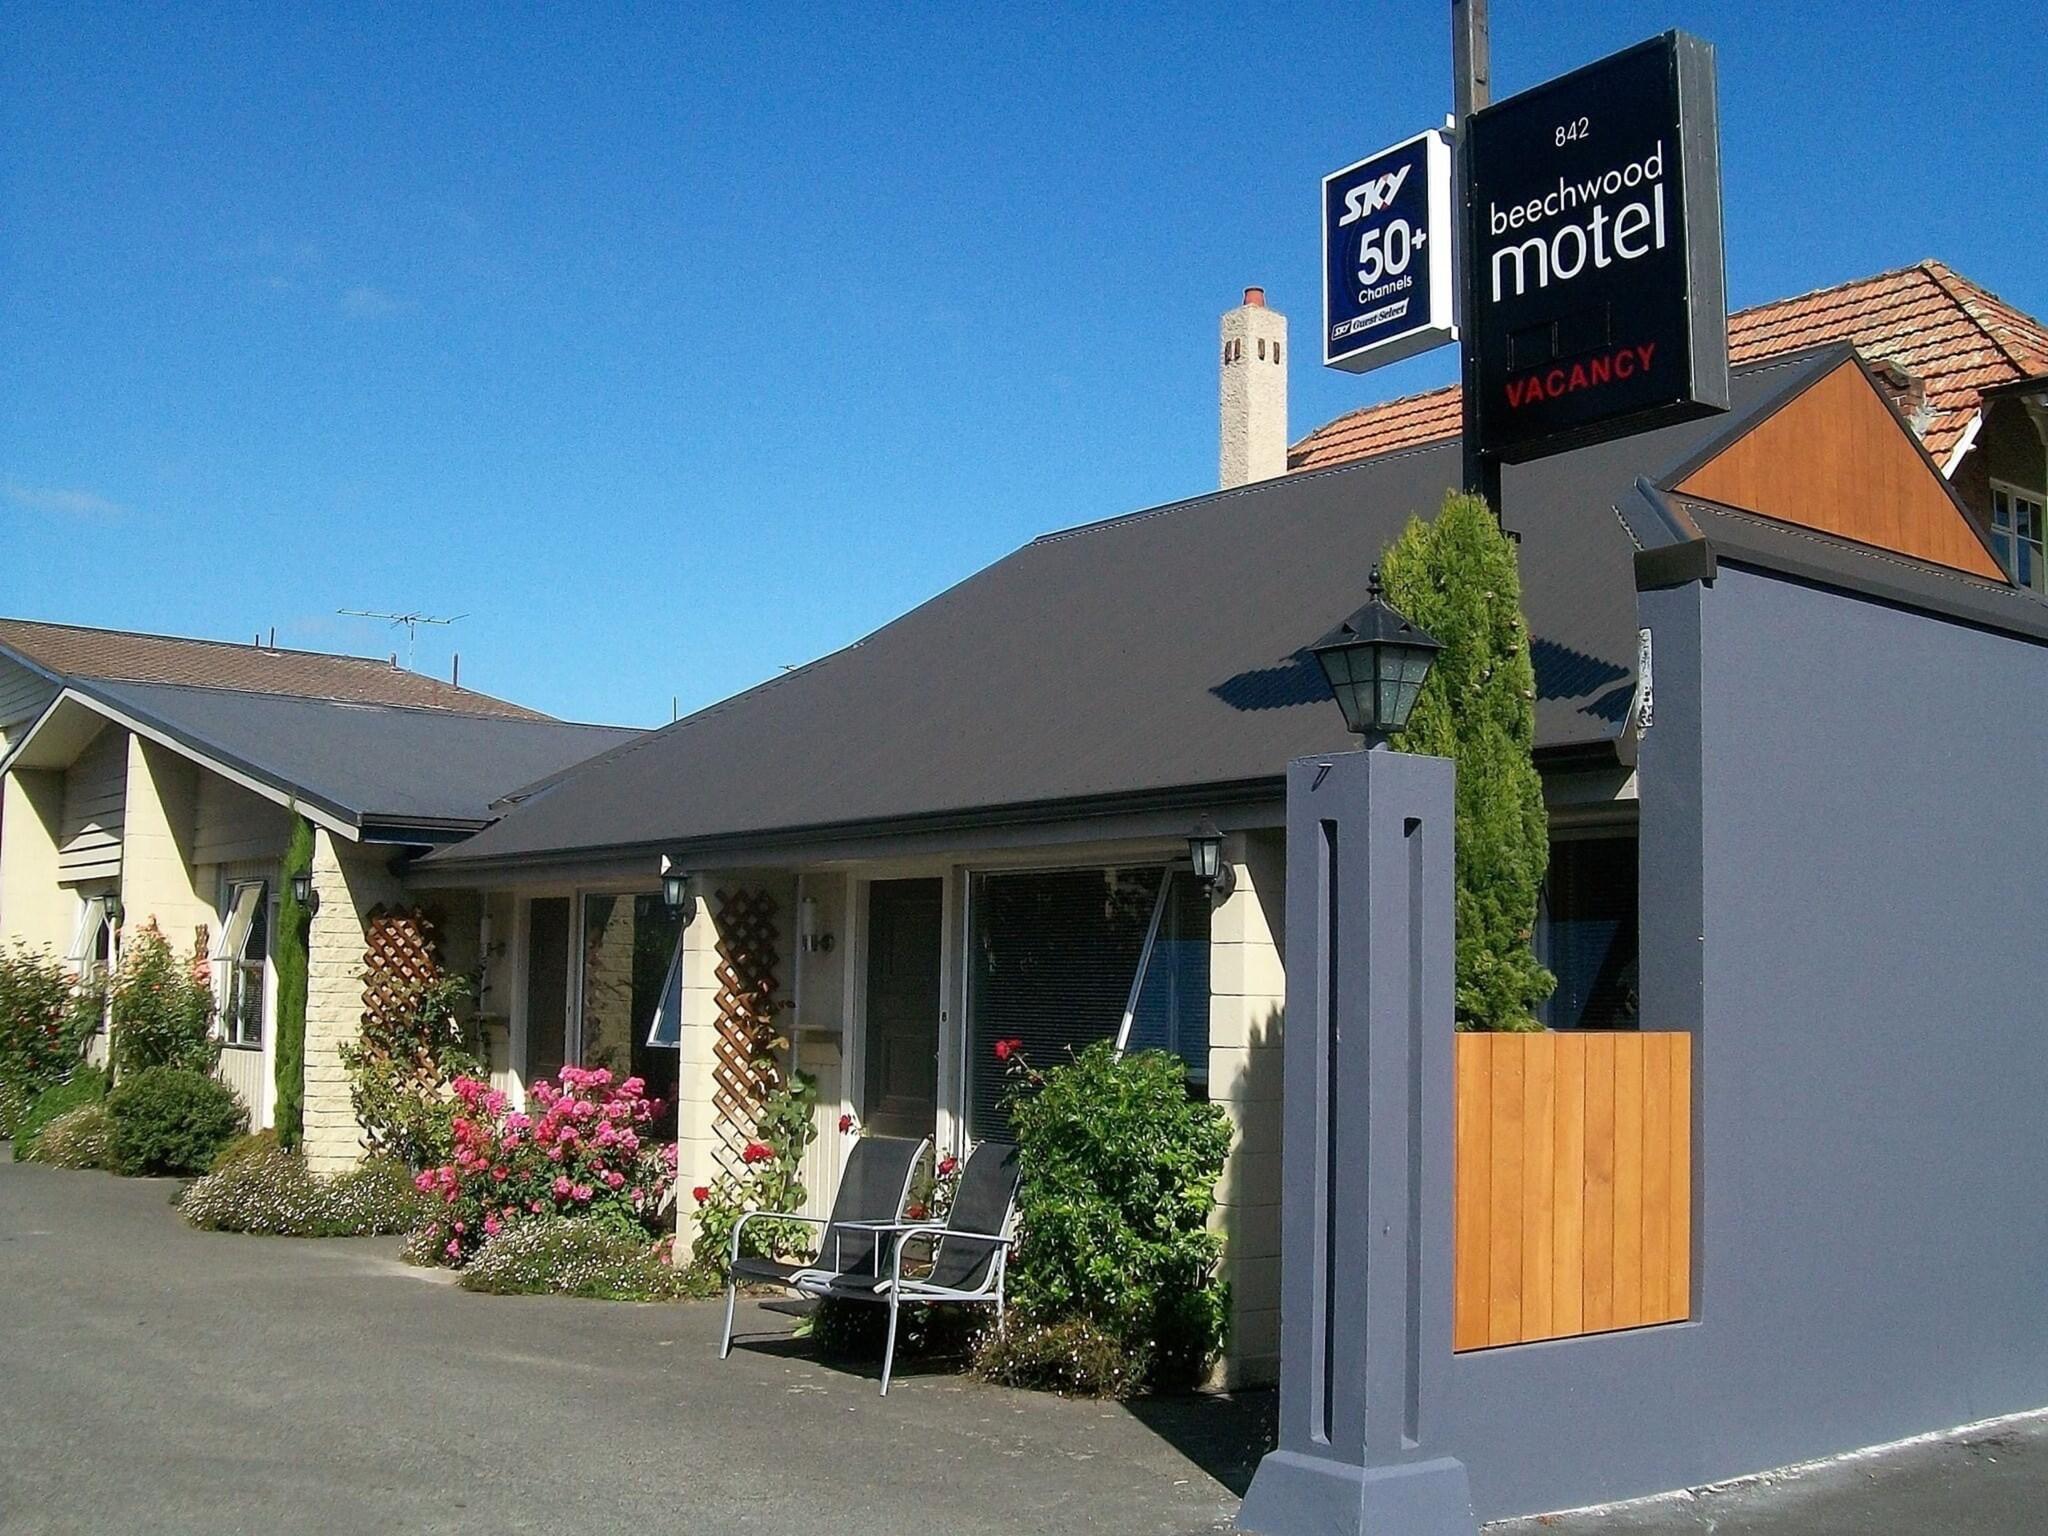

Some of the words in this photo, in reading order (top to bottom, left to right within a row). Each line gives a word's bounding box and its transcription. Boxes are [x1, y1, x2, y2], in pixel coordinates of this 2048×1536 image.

[1554, 116, 1590, 147] 842
[1339, 163, 1412, 228] SKY
[1490, 140, 1663, 236] beechwood
[1358, 218, 1427, 286] 50+
[1491, 183, 1666, 302] motel
[1333, 323, 1350, 337] SKY
[1353, 315, 1377, 330] Guest
[1378, 305, 1405, 321] Select
[1358, 273, 1413, 304] Channels
[1505, 342, 1657, 409] VACANCY
